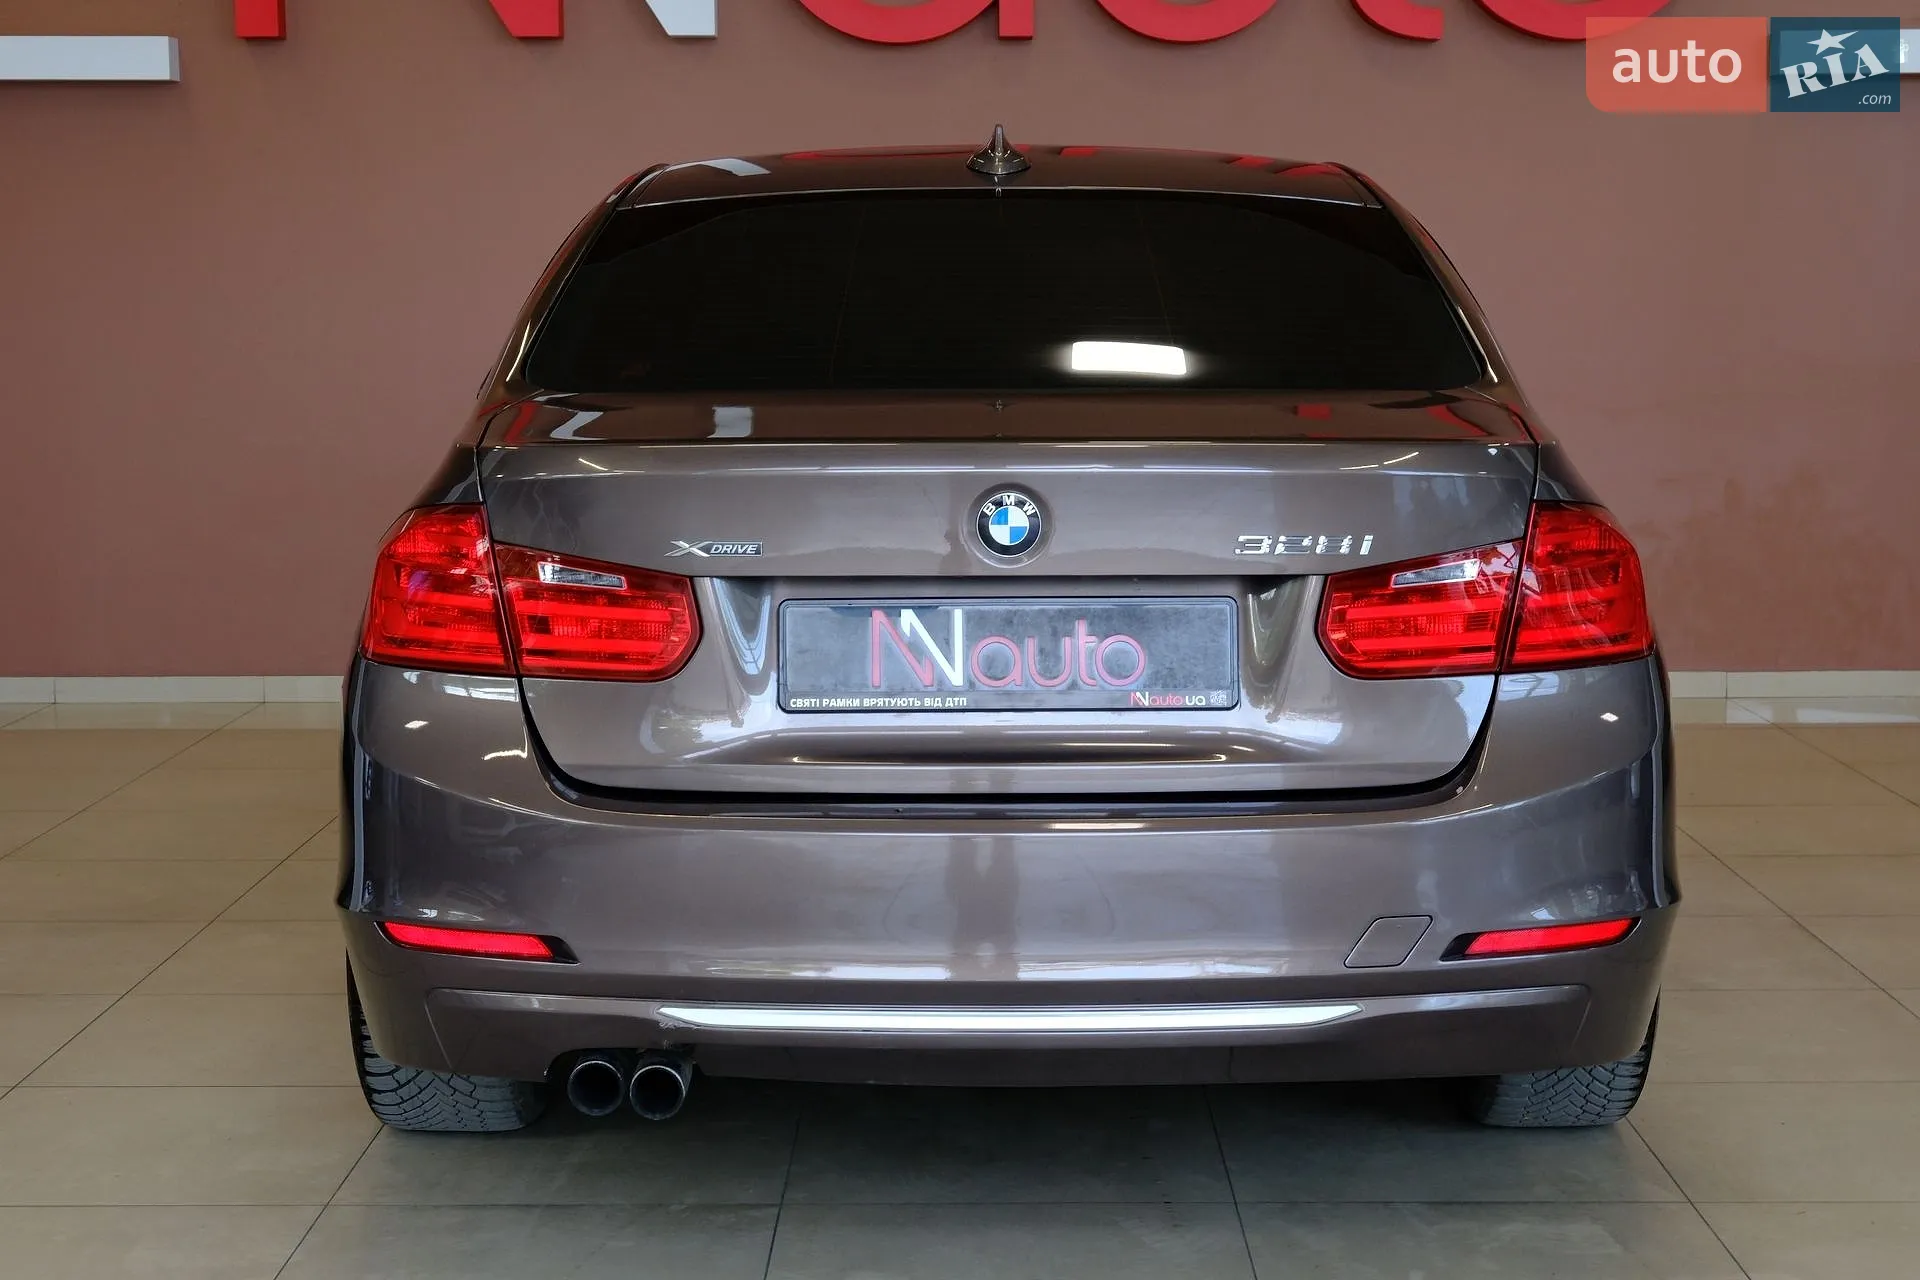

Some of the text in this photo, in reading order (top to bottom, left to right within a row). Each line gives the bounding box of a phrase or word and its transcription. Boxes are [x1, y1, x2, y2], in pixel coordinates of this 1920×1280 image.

[983, 495, 1036, 516] BMW
[1235, 535, 1374, 555] 328i
[871, 609, 1147, 687] NNauto
[790, 697, 967, 708] СВЯТІ РАМКИ ВРЯТУЮТЬ ВІД ДТП
